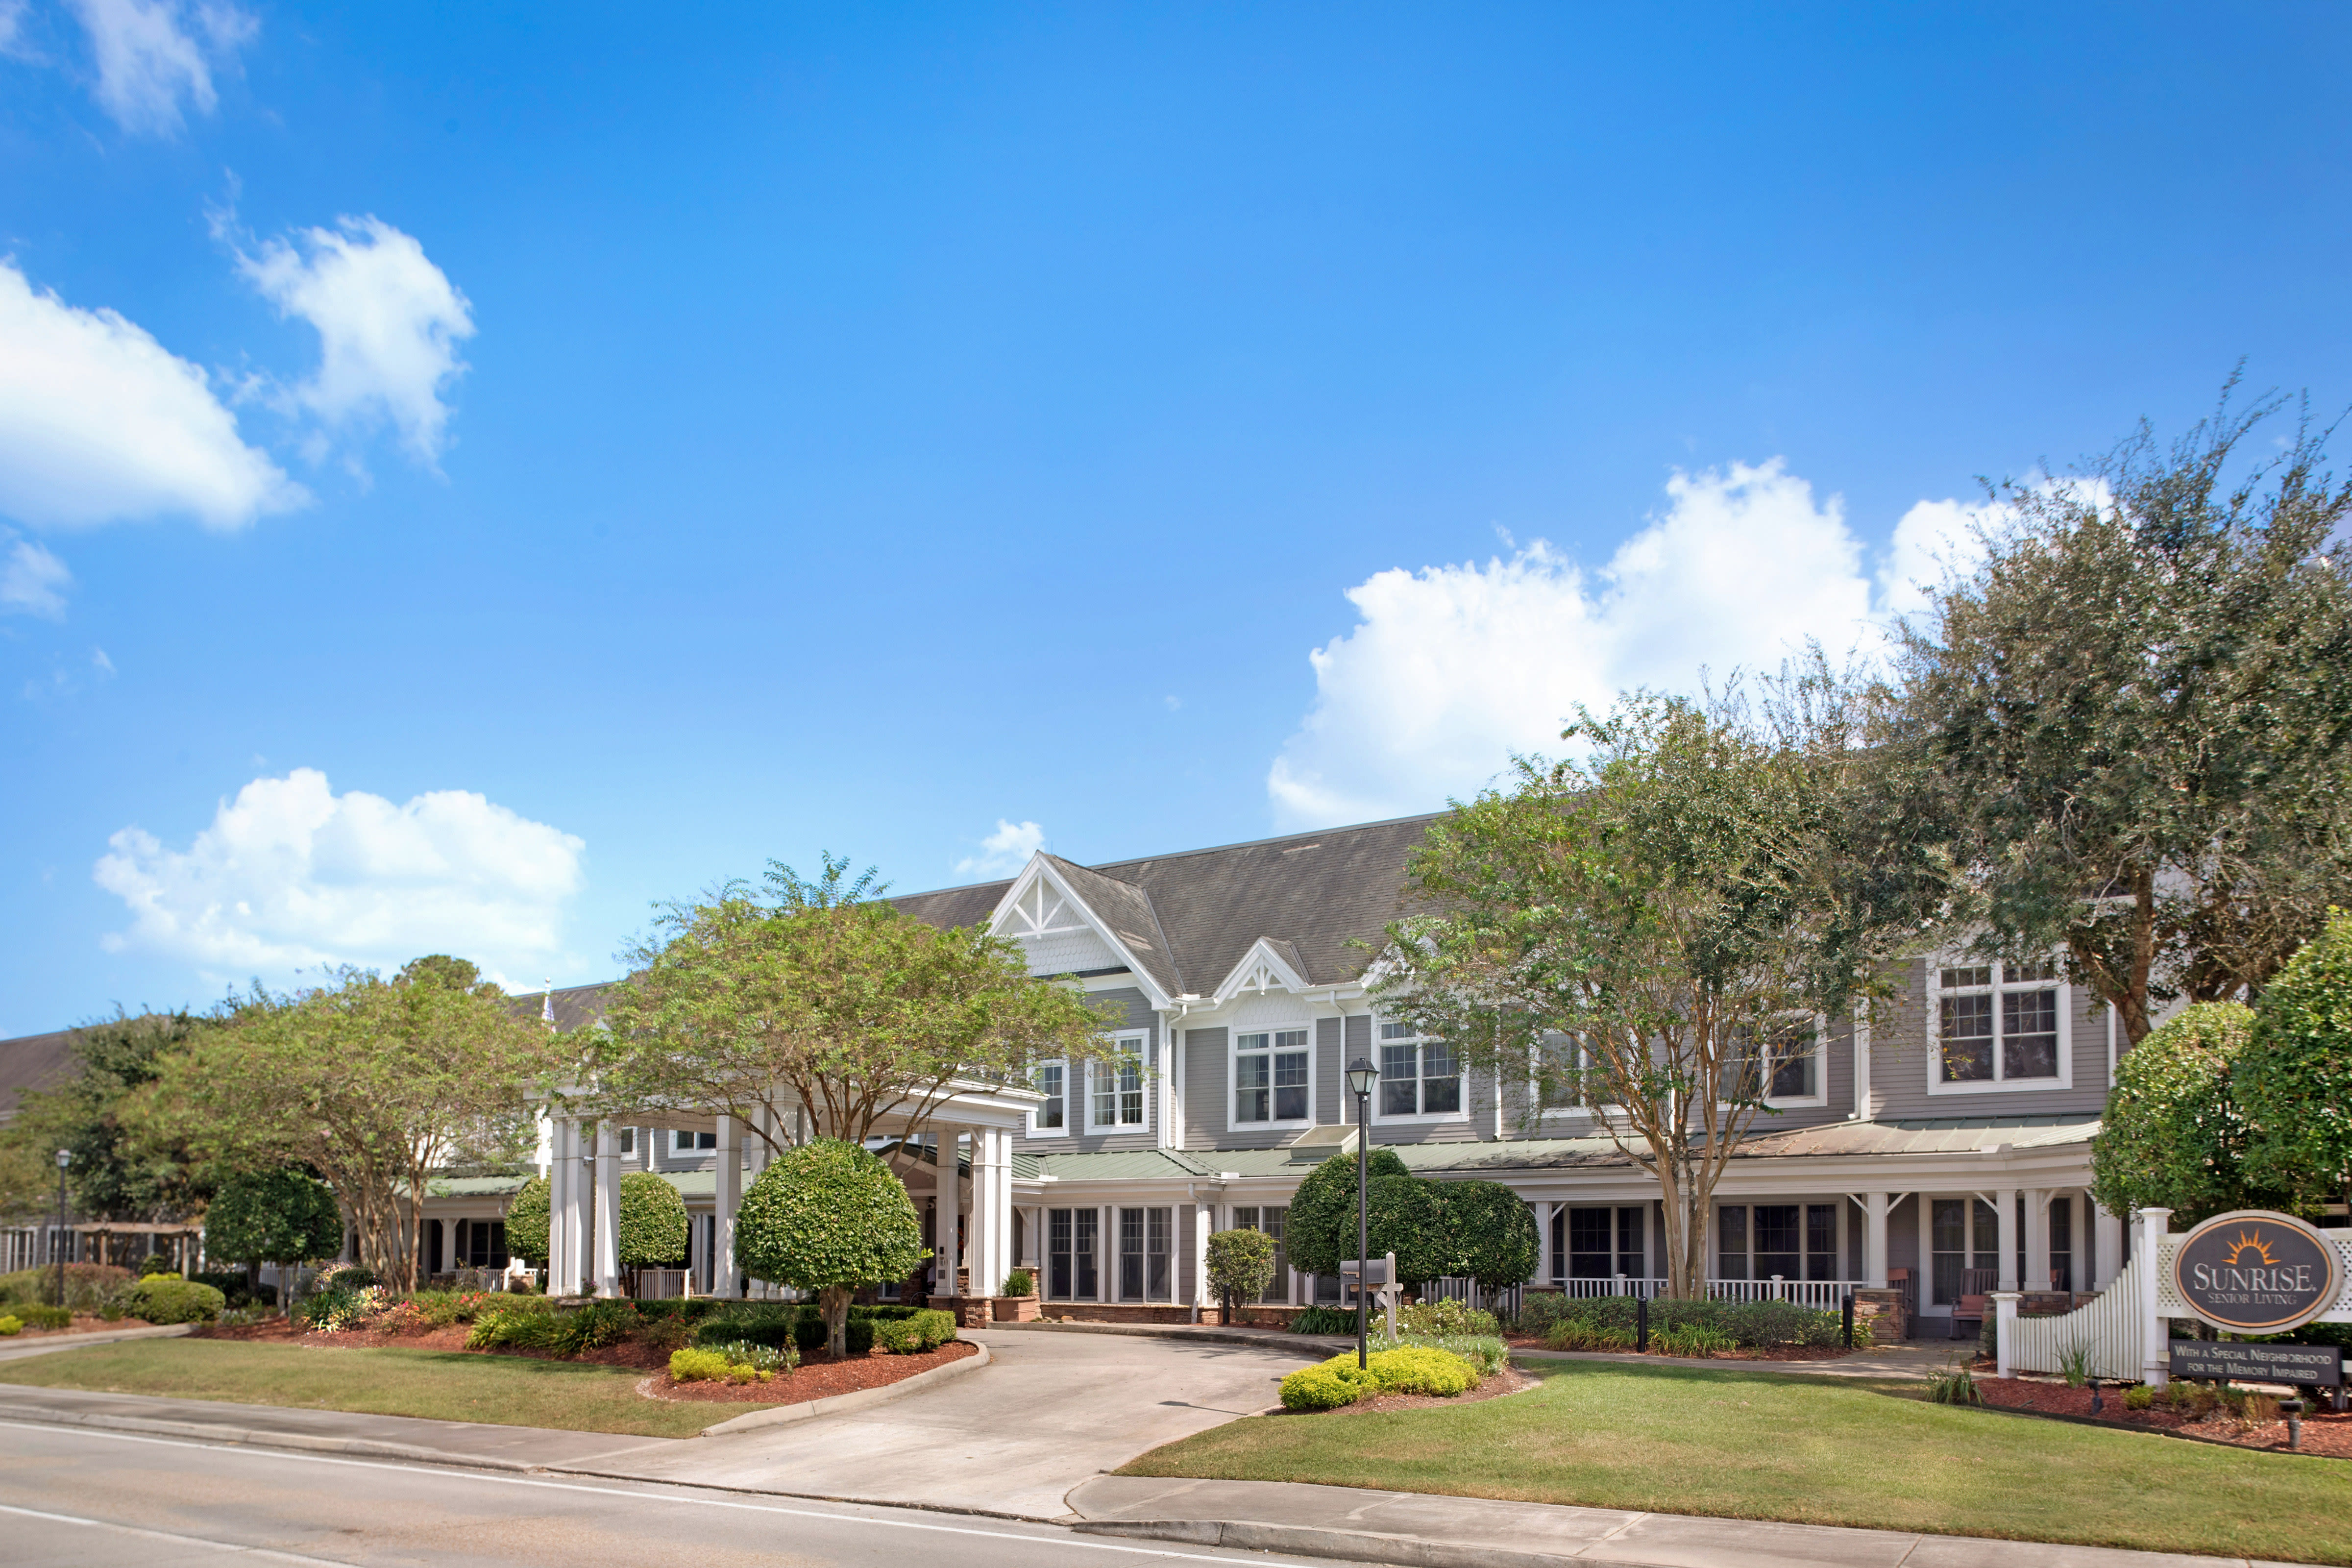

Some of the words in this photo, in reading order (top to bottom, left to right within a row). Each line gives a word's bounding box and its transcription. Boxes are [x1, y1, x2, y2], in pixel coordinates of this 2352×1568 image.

[2193, 1263, 2312, 1292] SUNRISE
[2207, 1292, 2249, 1304] SENIOR
[2254, 1293, 2297, 1305] LIVING
[2175, 1345, 2200, 1357] WITH
[2211, 1347, 2247, 1361] SPECIAL
[2250, 1349, 2331, 1365] NEIGHBORHOOD
[2226, 1362, 2269, 1377] MEMORY
[2272, 1365, 2318, 1380] IMPAIRED
